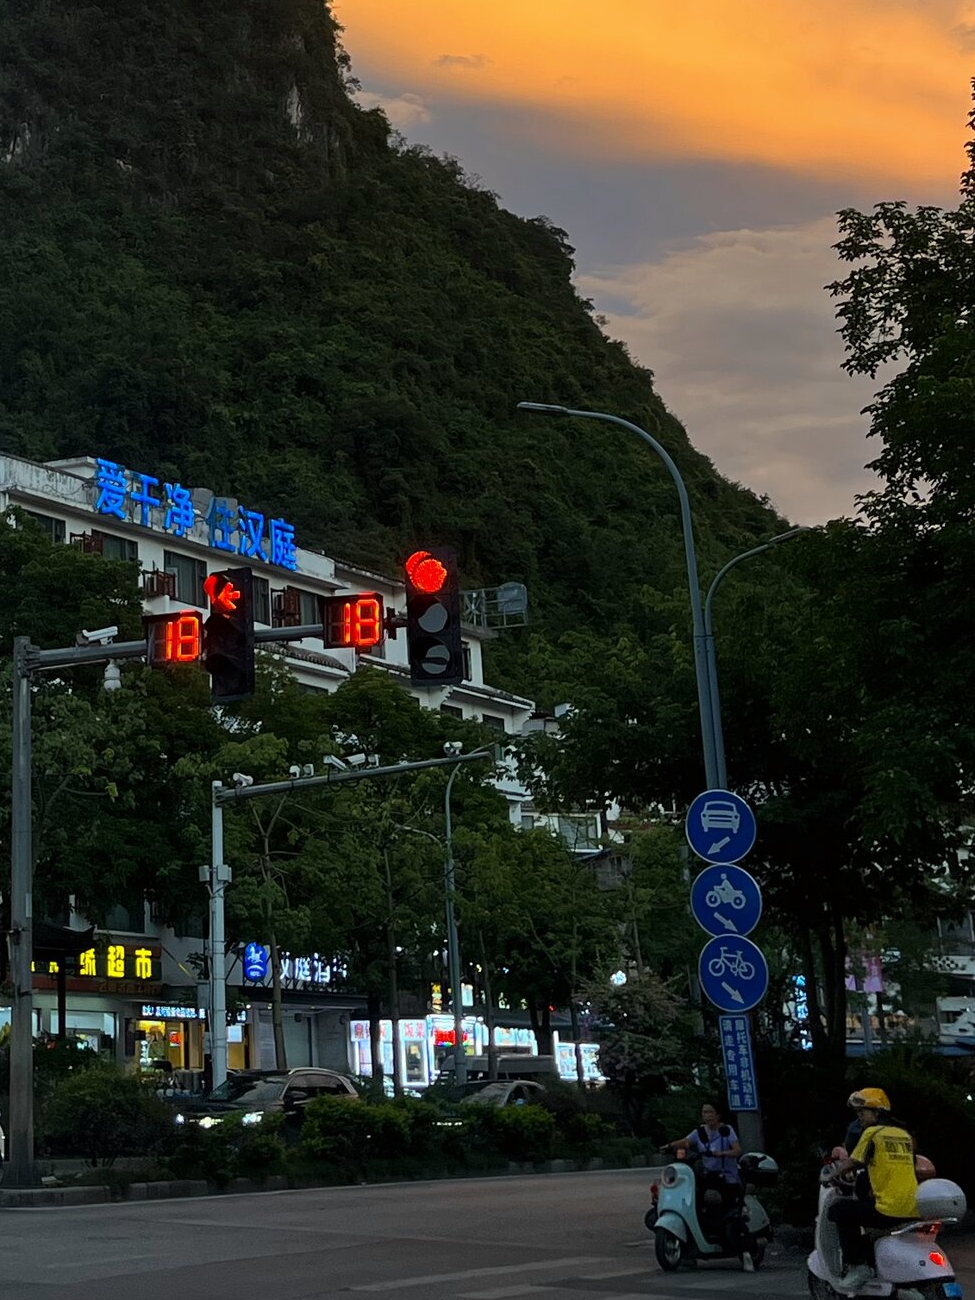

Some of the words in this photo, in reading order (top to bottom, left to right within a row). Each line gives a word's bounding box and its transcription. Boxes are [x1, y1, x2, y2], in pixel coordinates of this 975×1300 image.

[95, 457, 196, 537] 爱干净
[206, 497, 299, 572] 住汉庭
[165, 617, 200, 661] 18
[343, 598, 381, 646] 18
[721, 1018, 742, 1107] 请走专用车道
[734, 1018, 755, 1107] 摩托车非机动车
